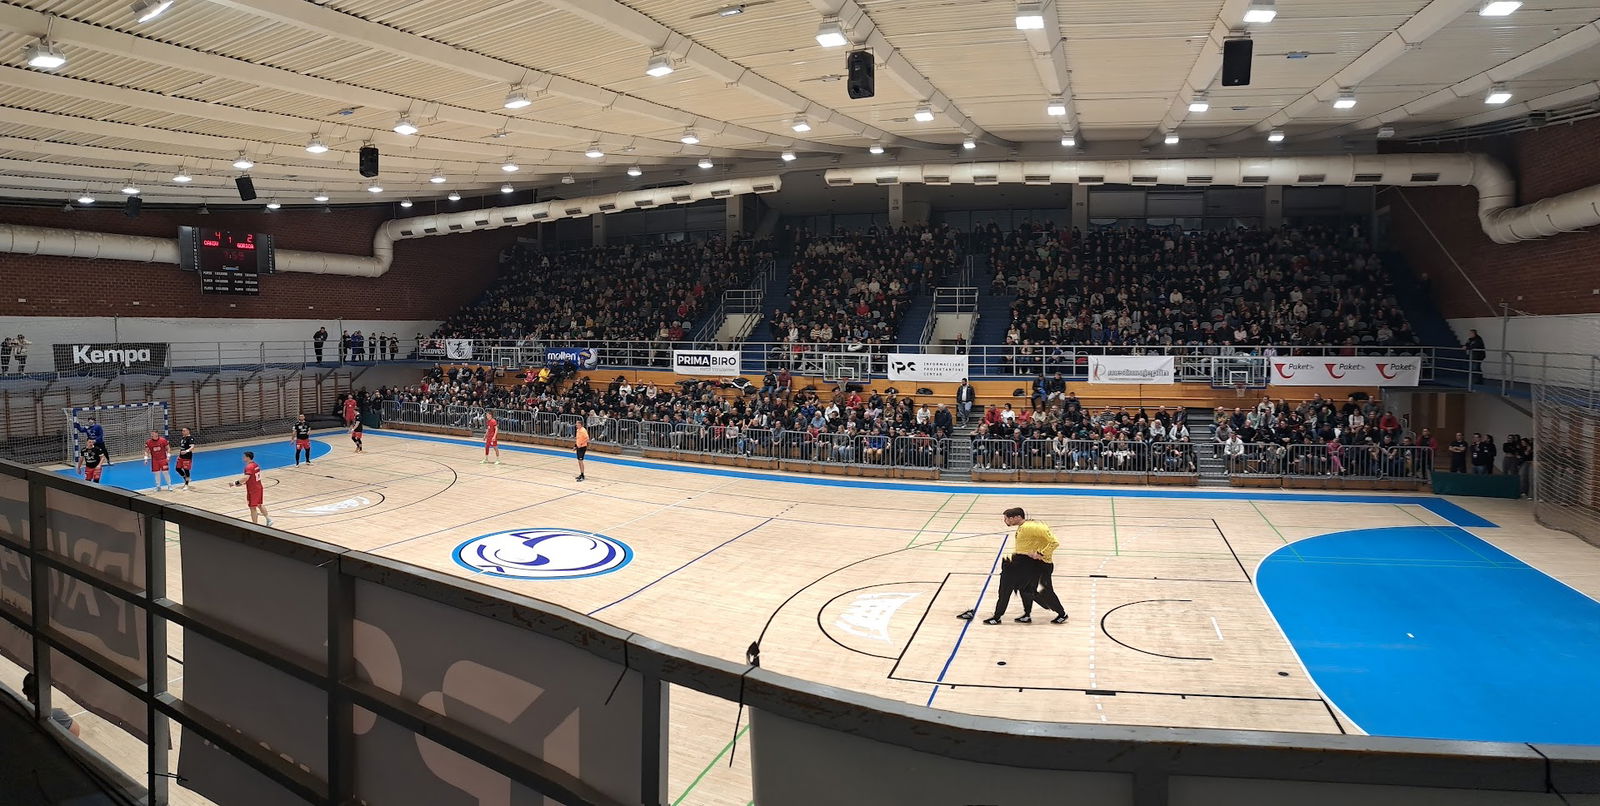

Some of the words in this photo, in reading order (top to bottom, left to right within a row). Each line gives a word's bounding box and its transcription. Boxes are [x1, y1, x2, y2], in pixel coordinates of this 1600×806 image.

[214, 231, 221, 240] 4
[247, 234, 253, 243] 2
[73, 345, 150, 367] Kempa
[547, 351, 576, 361] molten
[678, 356, 709, 365] PRIMA
[712, 357, 736, 366] BIRO
